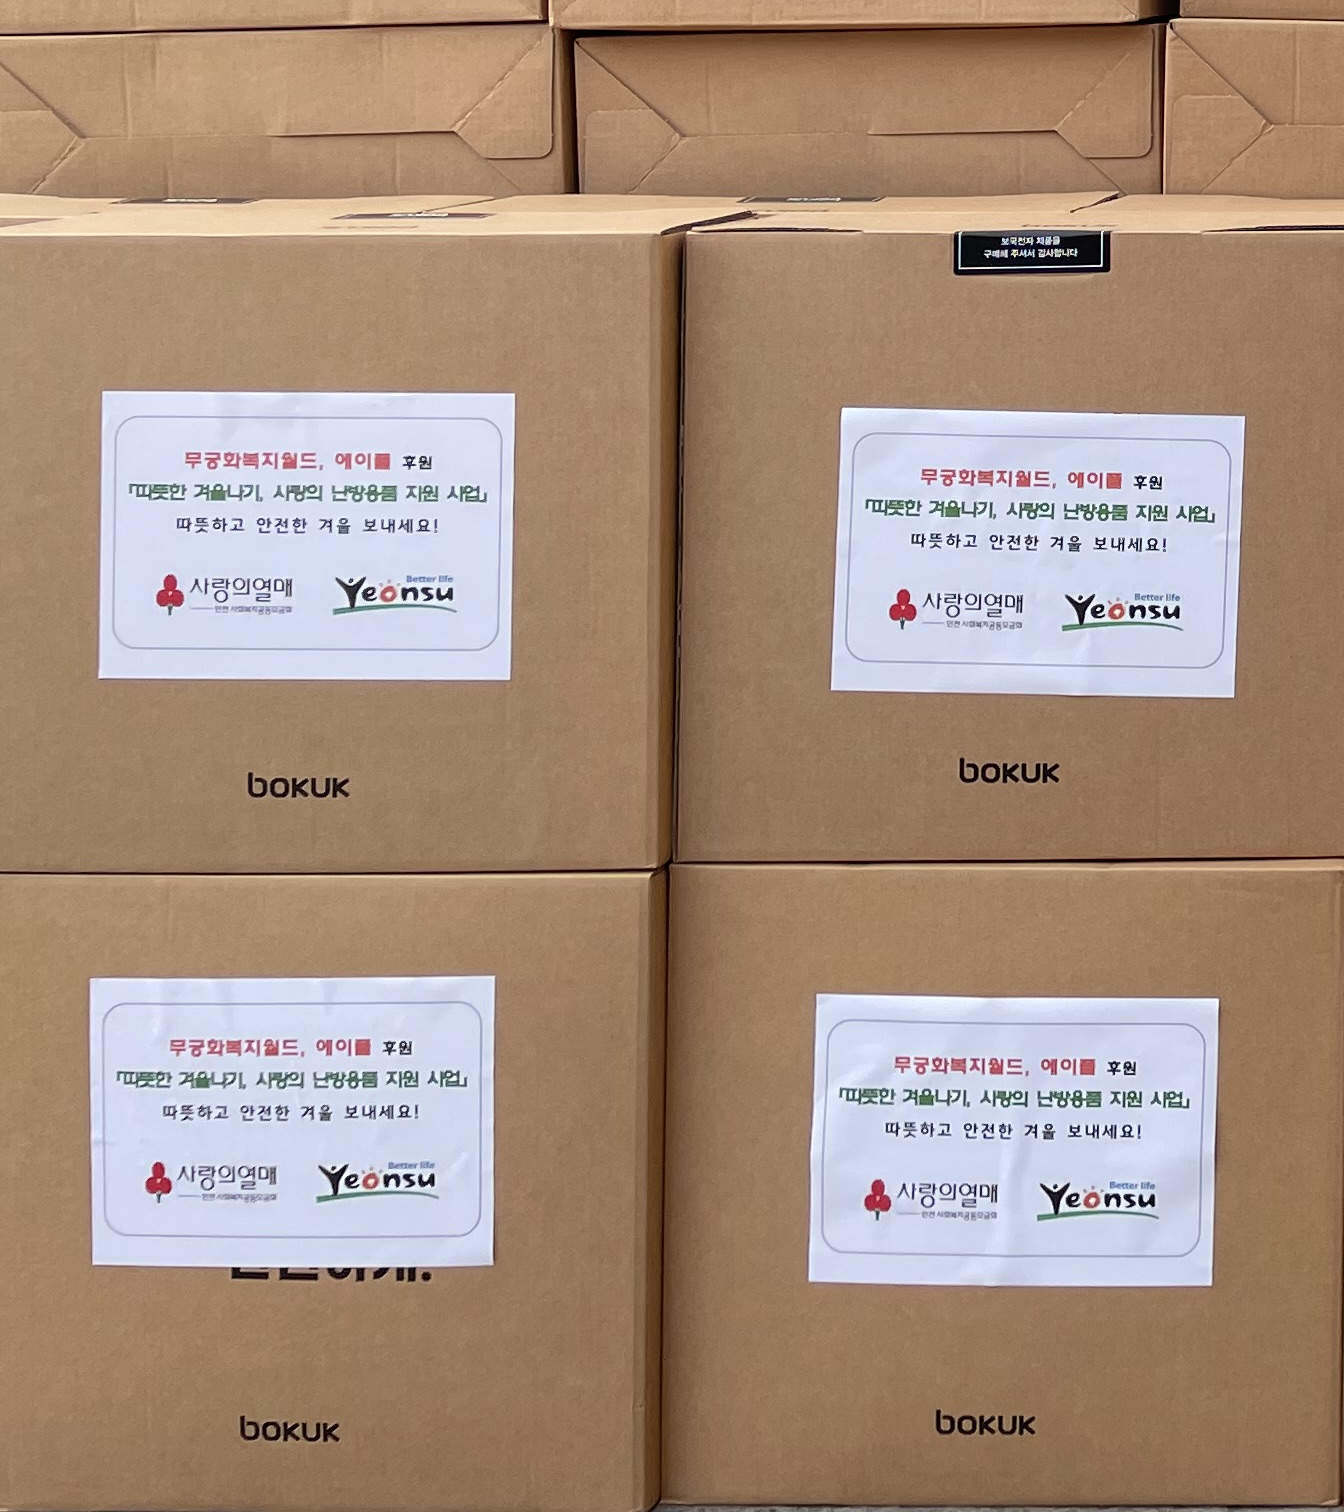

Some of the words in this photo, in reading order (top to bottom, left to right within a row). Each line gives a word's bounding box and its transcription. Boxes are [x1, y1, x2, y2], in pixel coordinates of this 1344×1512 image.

[921, 469, 1056, 489] 무궁화복지월드,
[1133, 475, 1162, 490] 후원
[177, 517, 245, 533] 따뜻하고
[256, 518, 307, 534] 안전한
[319, 518, 351, 534] 겨울
[362, 519, 438, 533] 보내세요!
[911, 533, 977, 549] 따뜻하고
[989, 534, 1039, 551] 안전한
[1050, 536, 1082, 552] 겨울
[1093, 537, 1166, 552] 보내세요!
[190, 578, 293, 603] 사랑의열매
[337, 575, 453, 611] Yeonsu
[922, 593, 1023, 618] 사랑의열매
[1067, 593, 1180, 629] Yeonsu
[895, 1056, 1029, 1077] 무궁화복지월드,
[1107, 1061, 1136, 1076] 후원
[163, 1105, 229, 1121] 따뜻하고
[240, 1105, 290, 1121] 안전한
[301, 1105, 332, 1121] 겨울
[344, 1104, 418, 1120] 보내세요!
[885, 1122, 952, 1138] 따뜻하고
[964, 1123, 1013, 1140] 안전한
[1024, 1124, 1056, 1140] 겨울
[1068, 1124, 1141, 1139] 보내세요!
[176, 1165, 276, 1191] 사랑의열매
[318, 1161, 435, 1198] Yeonsu
[897, 1183, 998, 1208] 사랑의열매
[1042, 1182, 1155, 1217] Yeonsu
